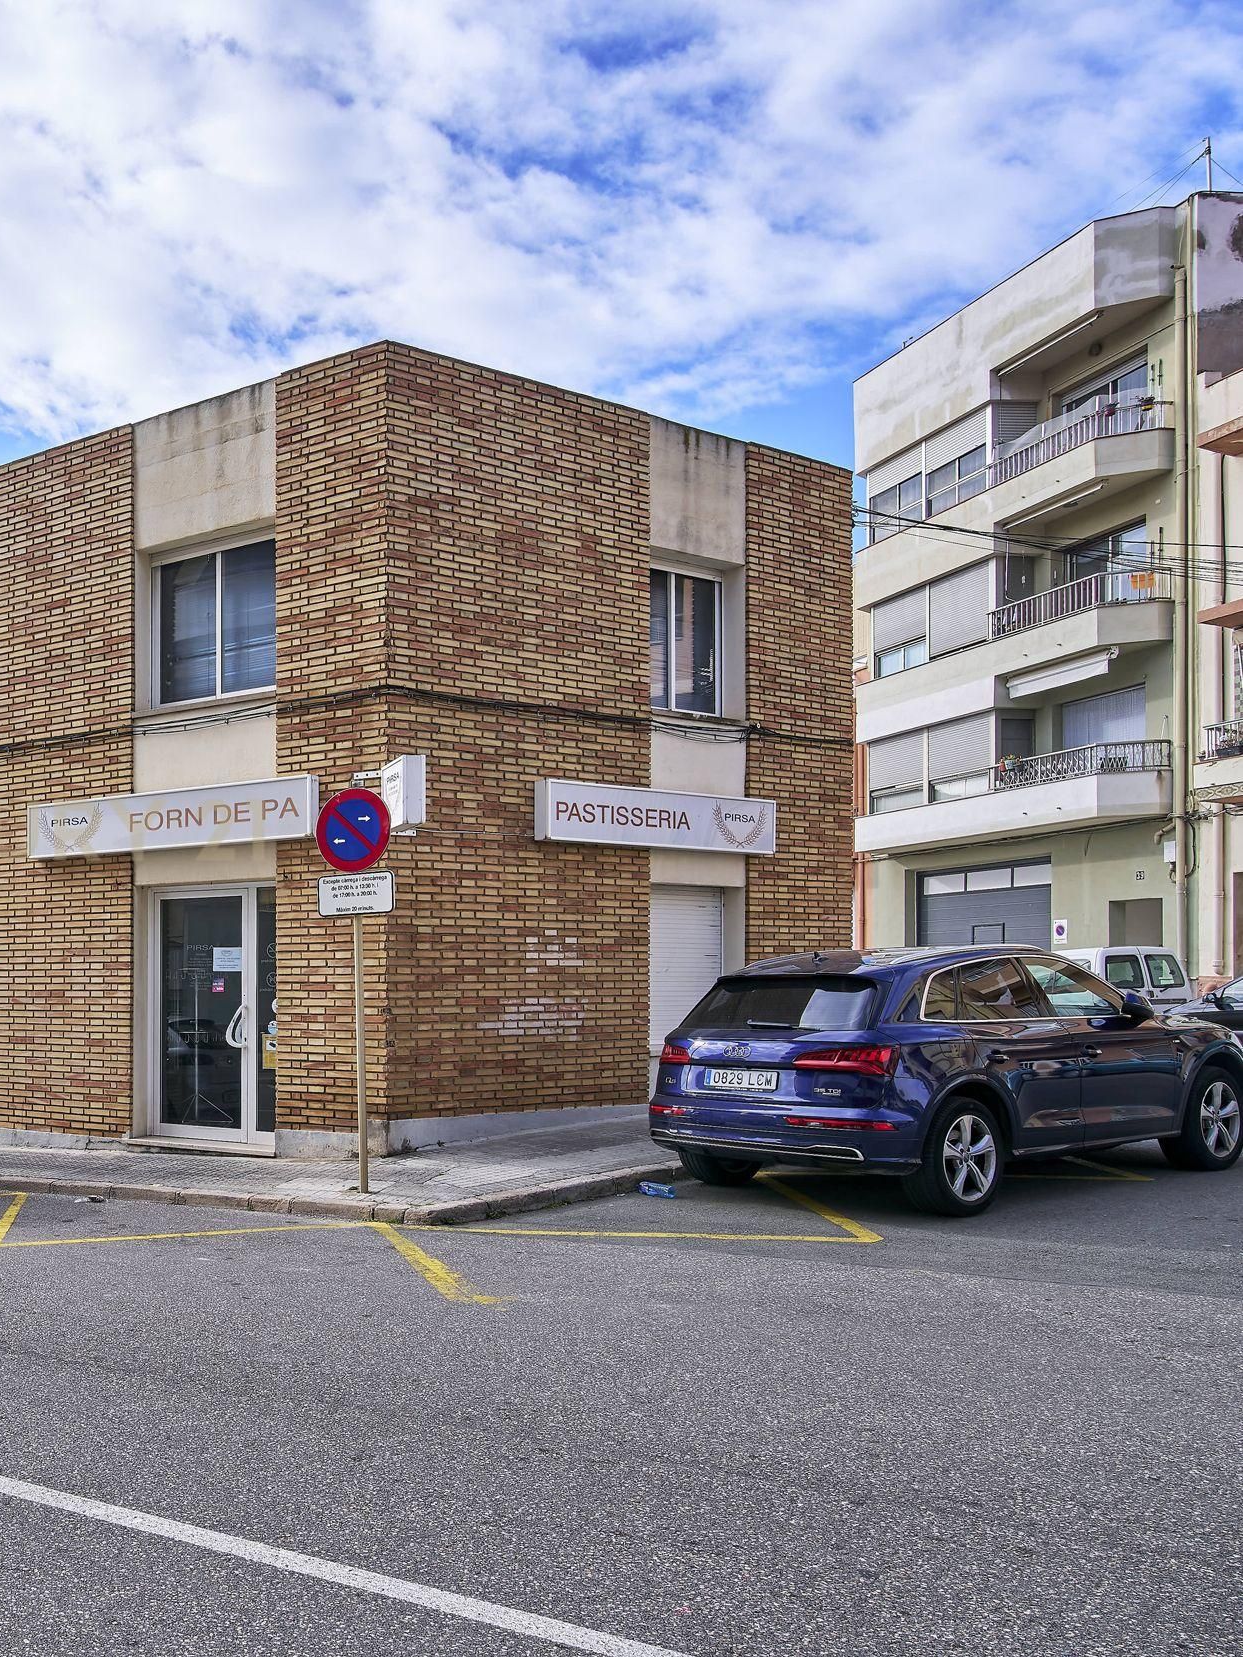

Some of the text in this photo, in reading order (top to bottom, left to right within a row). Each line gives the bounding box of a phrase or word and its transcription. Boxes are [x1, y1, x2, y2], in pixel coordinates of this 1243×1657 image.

[50, 815, 89, 828] PIRSA
[129, 797, 300, 833] FORN DE PA
[555, 801, 691, 831] PASTISSERIA
[724, 812, 756, 824] PIRSA
[713, 1071, 773, 1087] 0829 LCM
